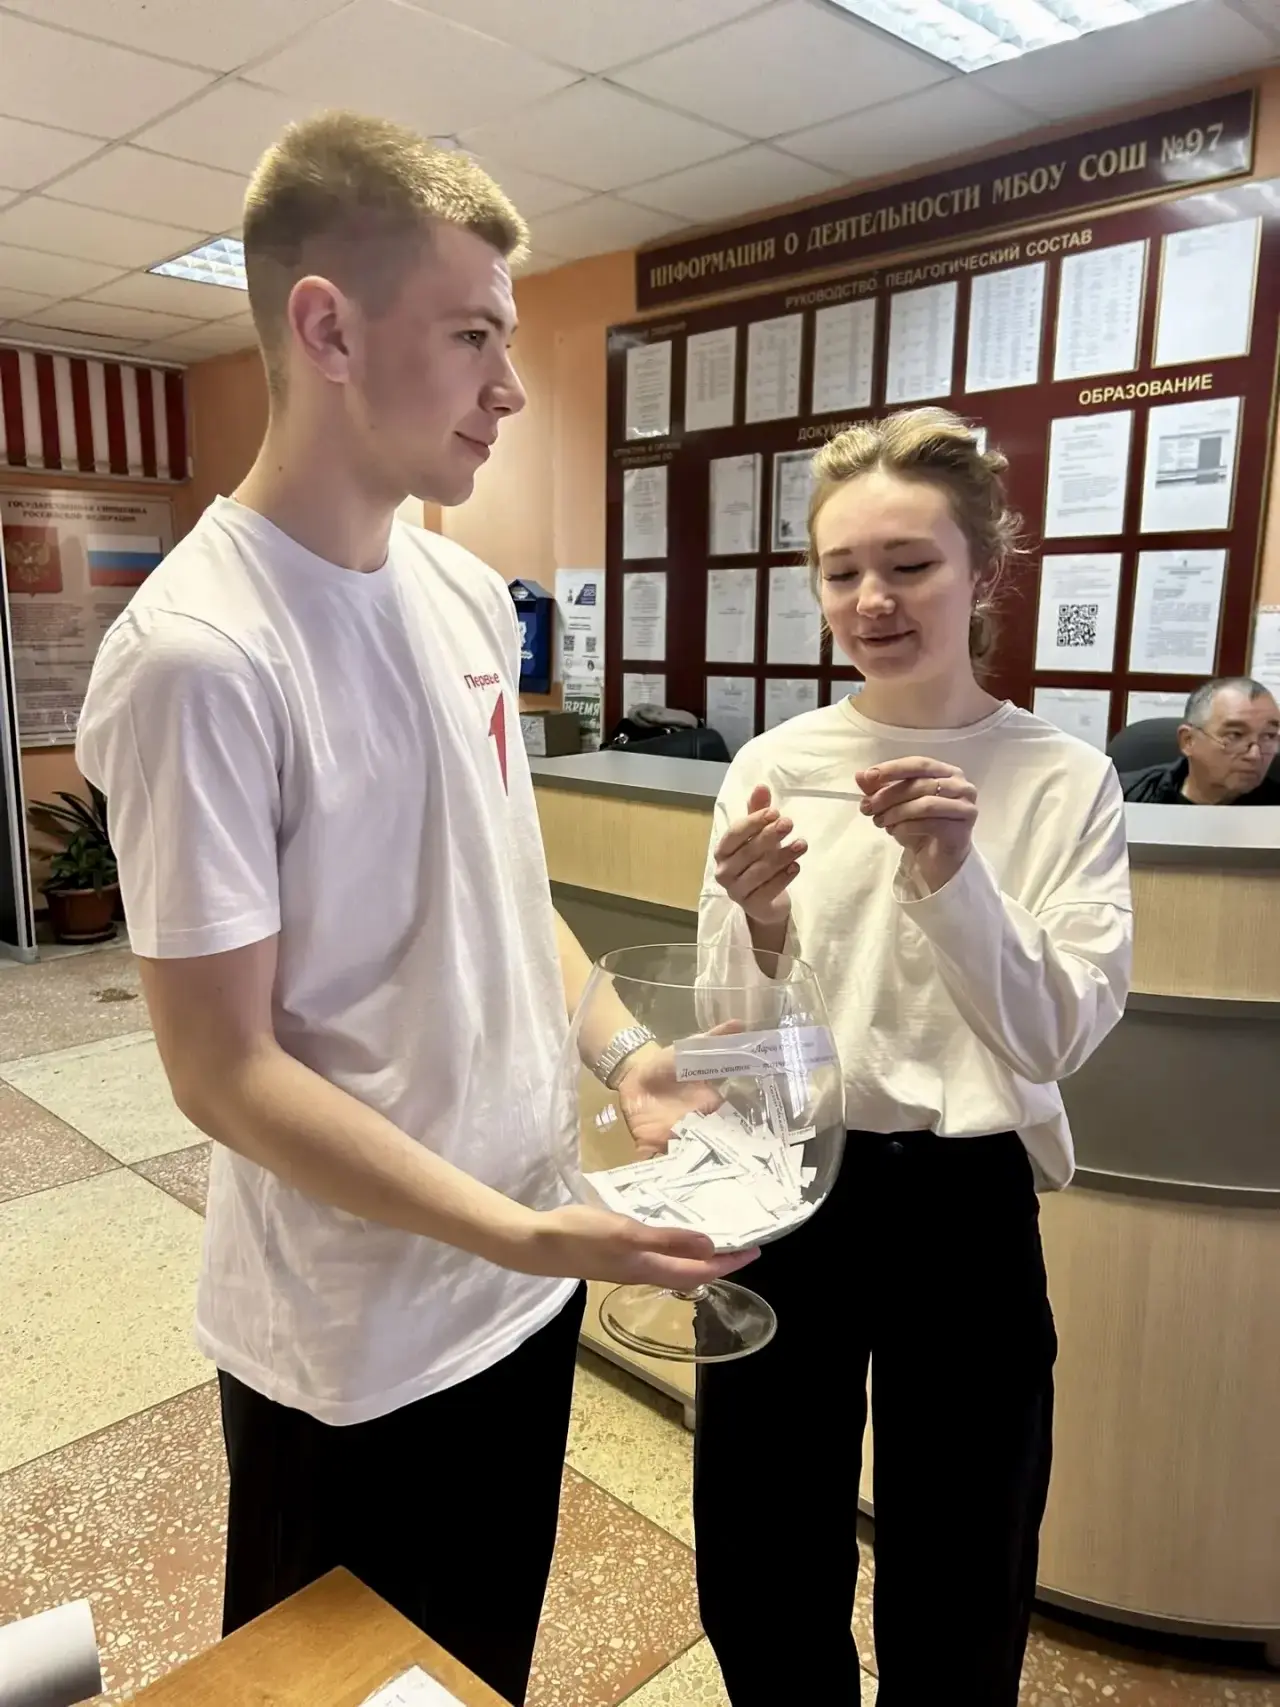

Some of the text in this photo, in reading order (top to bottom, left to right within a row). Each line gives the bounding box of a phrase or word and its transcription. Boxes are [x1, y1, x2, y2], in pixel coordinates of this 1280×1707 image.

[650, 121, 1224, 289] ИНФОРМАЦИЯ О ДЕЯТЕЛЬНОСТИ МБОУ СОШ №97
[886, 242, 1020, 288] ПЕДАГОГИЧЕСКИЙ
[1026, 228, 1093, 257] СОСТАВ
[1078, 373, 1214, 405] ОБРАЗОВАНИЕ
